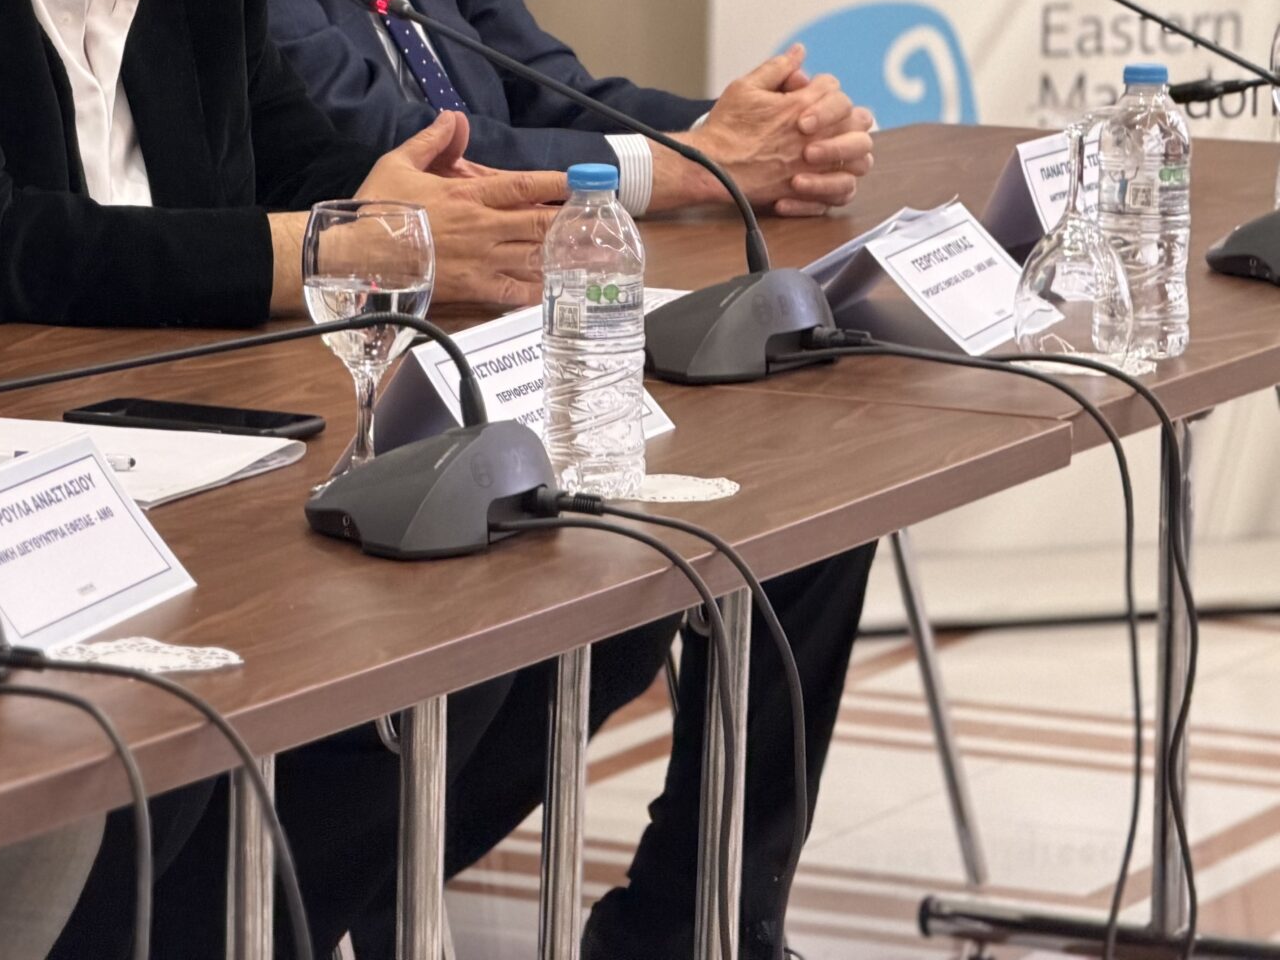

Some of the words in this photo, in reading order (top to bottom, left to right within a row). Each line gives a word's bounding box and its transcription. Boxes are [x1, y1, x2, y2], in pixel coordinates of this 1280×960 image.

[1040, 3, 1242, 59] Eastern
[470, 346, 540, 381] ΙΣΤΟΔΟΥΛΟΣ
[495, 378, 544, 404] ΠΕΡΙΦΕΡΕΙΑΡ
[30, 472, 96, 512] ΑΝΑΣΤΑΣΙΟΥ
[15, 526, 67, 557] ΔΙΕΥΘΥΝΤΡΙΑ
